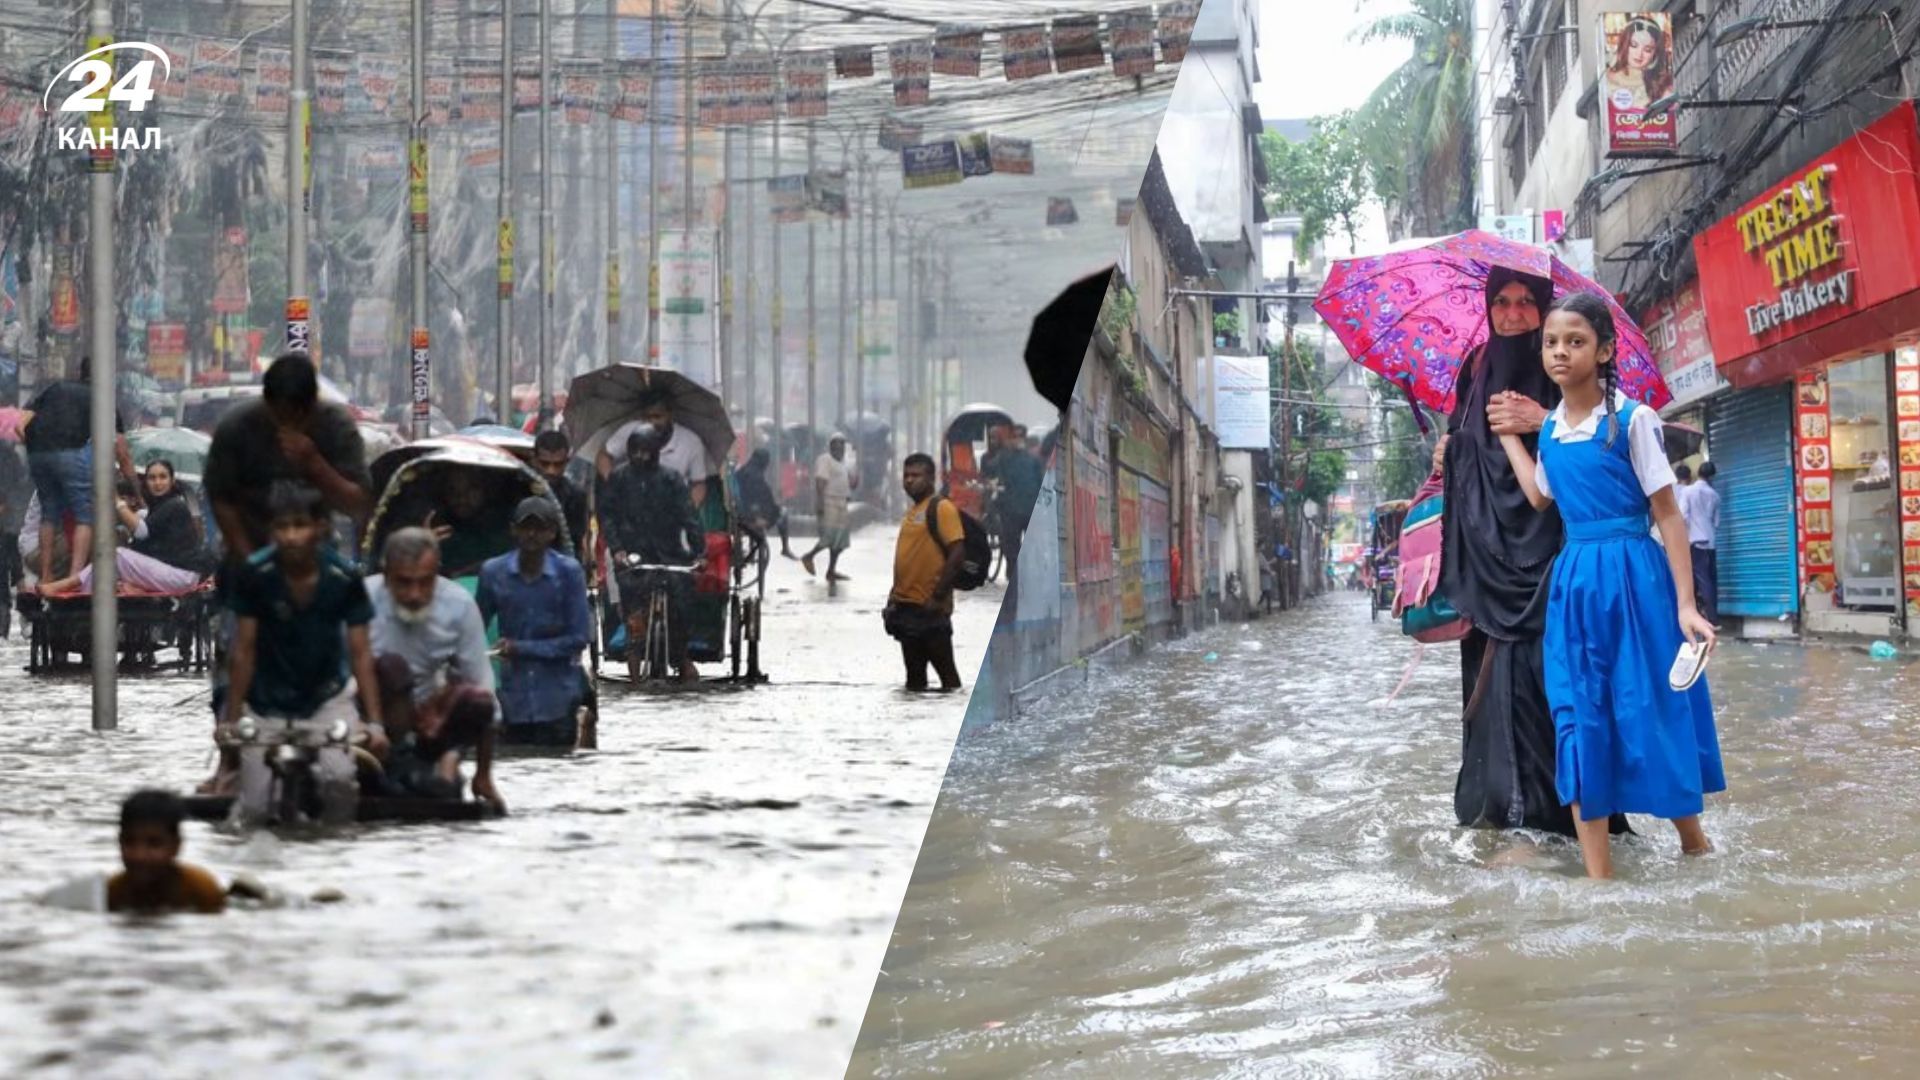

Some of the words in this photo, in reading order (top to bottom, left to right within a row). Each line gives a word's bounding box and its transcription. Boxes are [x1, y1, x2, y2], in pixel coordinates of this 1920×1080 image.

[1737, 165, 1828, 253] TREAT
[1766, 216, 1839, 288] TIME
[1745, 301, 1781, 336] Live
[1780, 270, 1850, 321] Bakery
